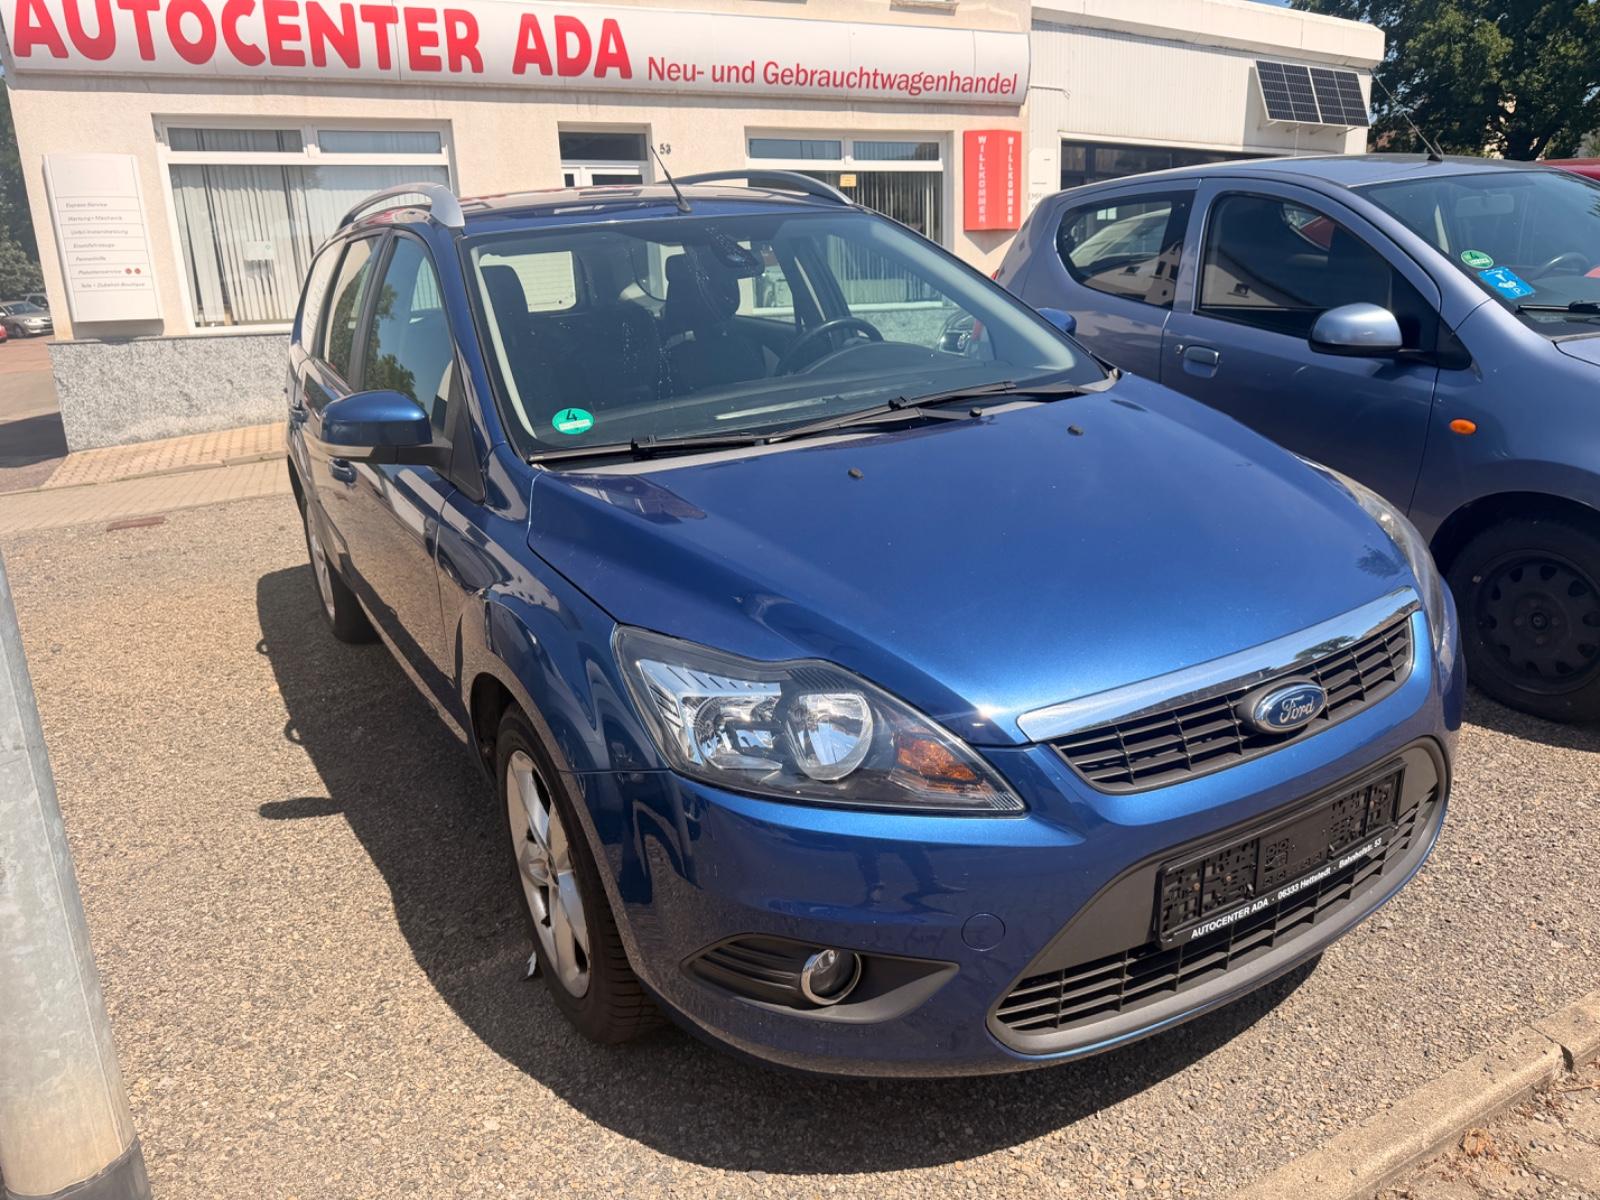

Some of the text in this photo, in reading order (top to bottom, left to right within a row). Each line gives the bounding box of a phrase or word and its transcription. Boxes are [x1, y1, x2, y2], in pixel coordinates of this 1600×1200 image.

[13, 0, 633, 79] AUTOCENTER ADA
[648, 56, 1018, 97] Neu- und Gebrauchtwagenhandel
[977, 135, 987, 223] WILLKOMMEN
[566, 409, 577, 421] 4
[1280, 695, 1314, 723] Ford
[1191, 908, 1250, 939] AUTOCENTER
[1251, 898, 1269, 913] ADA
[1277, 880, 1300, 899] 06333
[1299, 866, 1333, 890] Hettstedt
